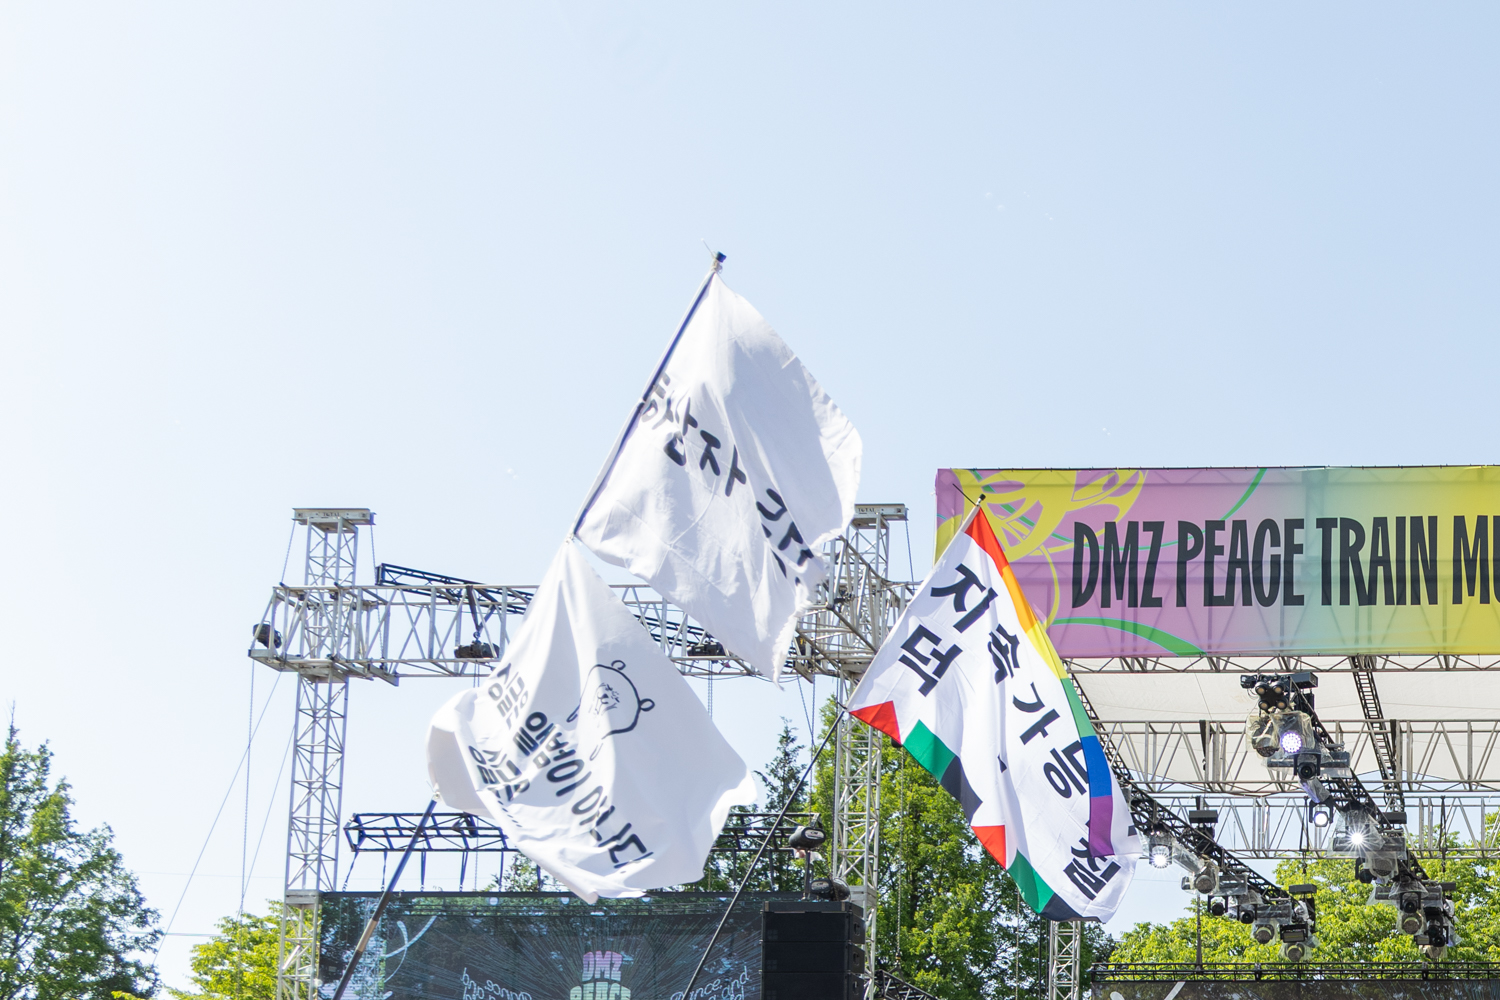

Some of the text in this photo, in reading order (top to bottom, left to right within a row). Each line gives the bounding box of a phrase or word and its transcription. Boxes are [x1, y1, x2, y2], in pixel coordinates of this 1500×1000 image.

[1072, 521, 1164, 608] DMZ
[1177, 519, 1304, 607] PEACE
[1316, 516, 1437, 606] TRAIN
[582, 951, 623, 981] DMZ
